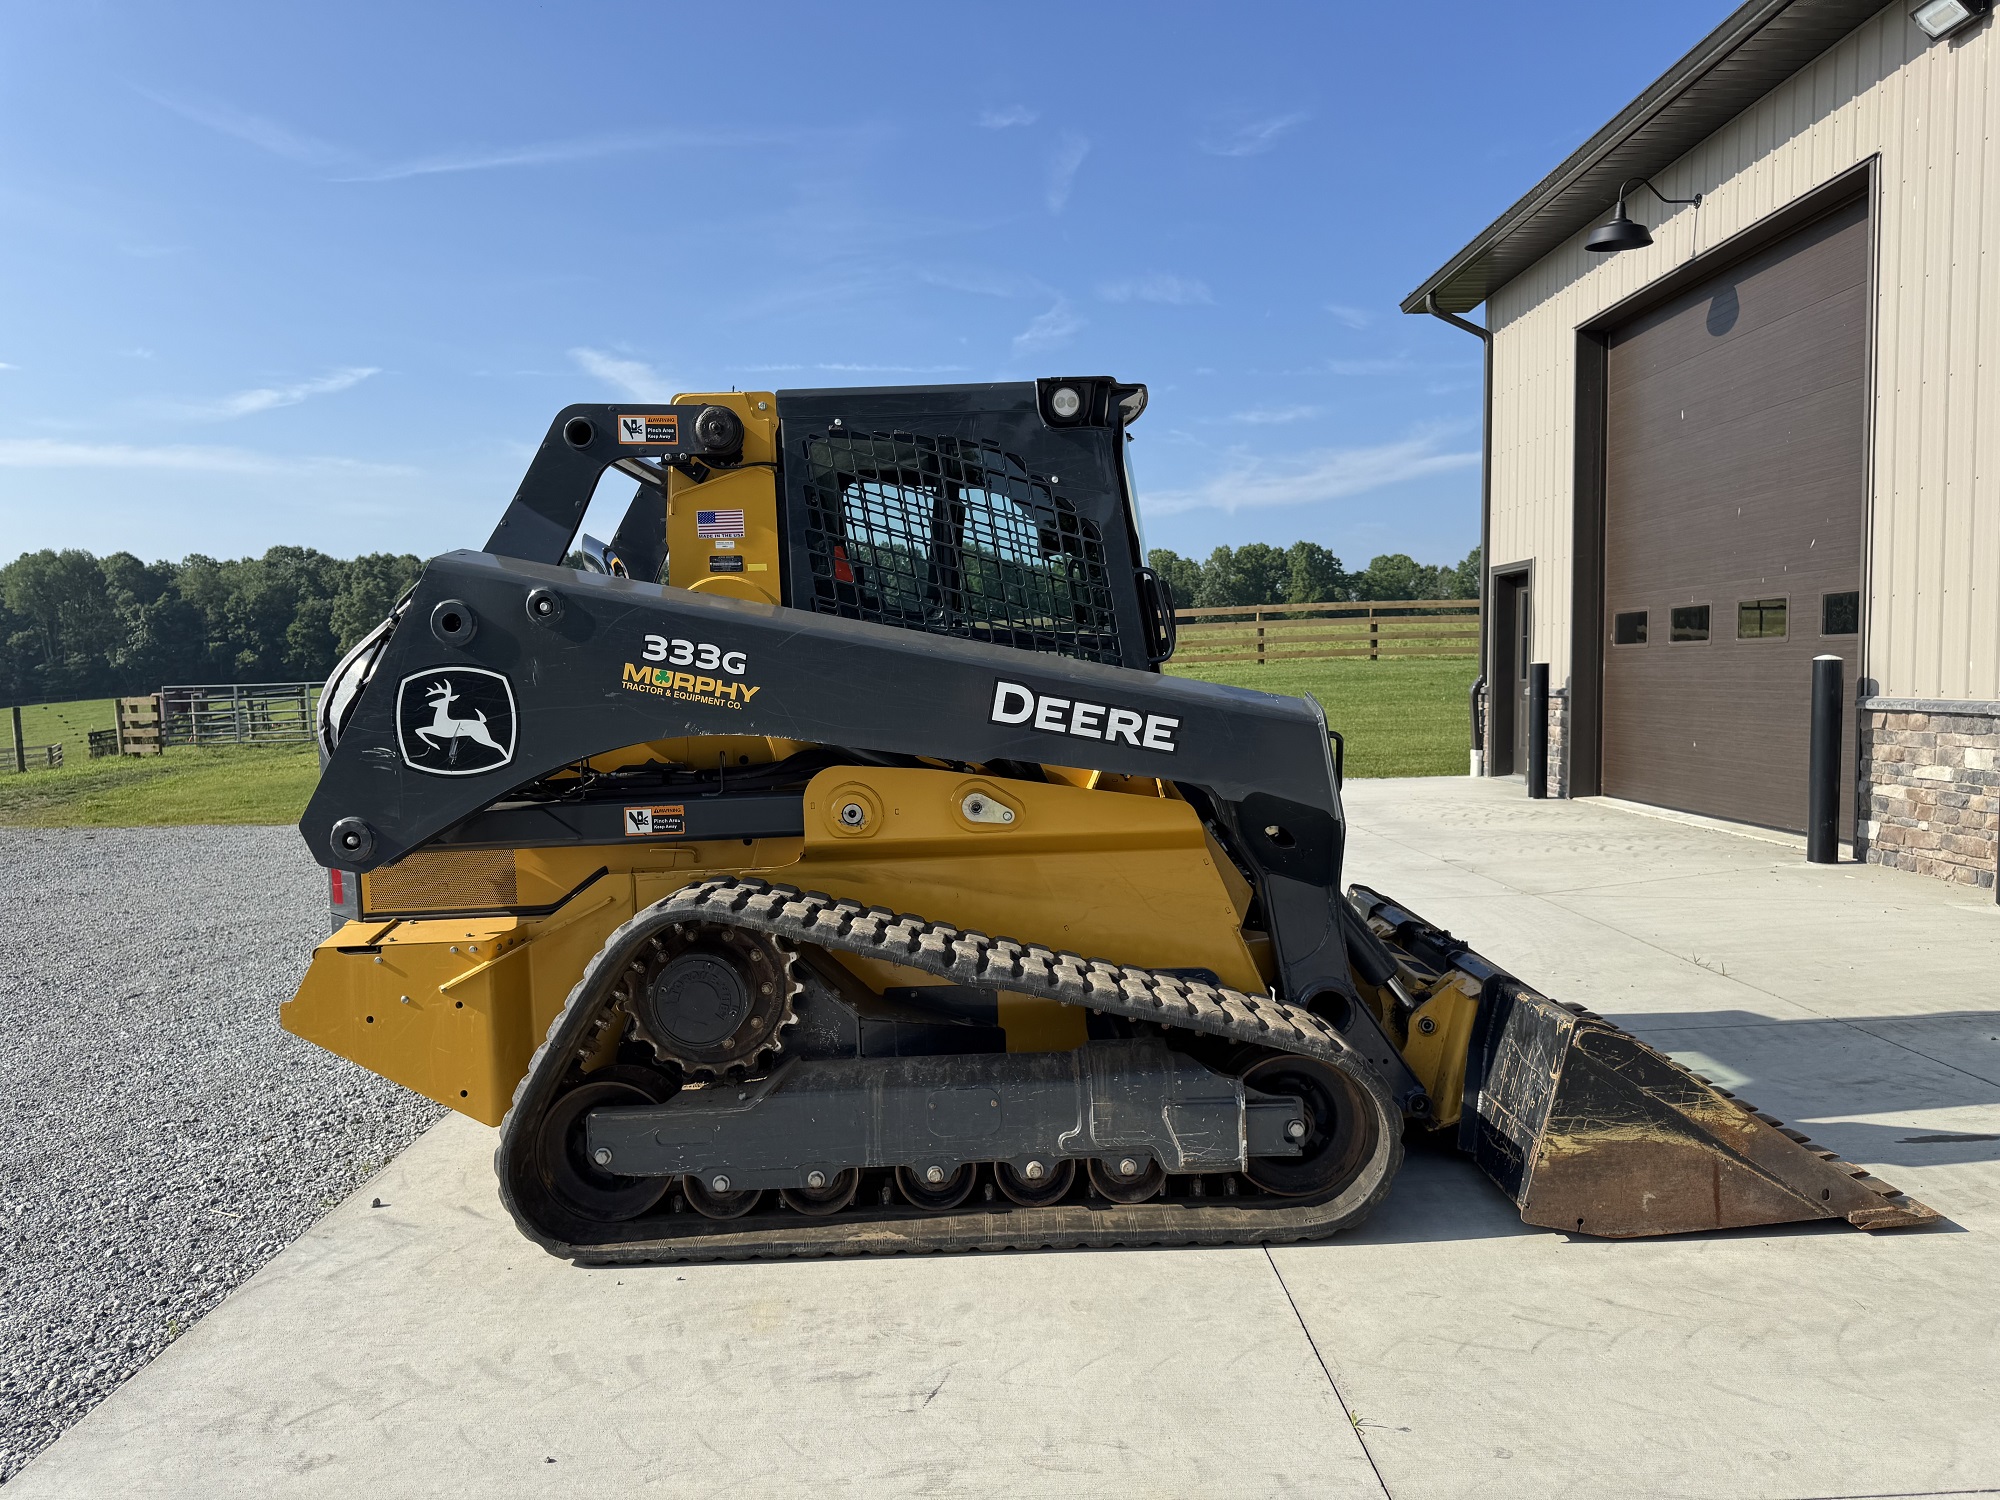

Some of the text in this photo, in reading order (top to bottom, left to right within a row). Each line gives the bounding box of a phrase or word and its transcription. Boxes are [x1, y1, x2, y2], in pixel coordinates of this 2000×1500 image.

[642, 634, 747, 675] 333G
[621, 681, 743, 710] TRACTOR & EQUIPMENT CO.
[622, 662, 761, 703] MURPHY
[991, 681, 1180, 752] DEERE
